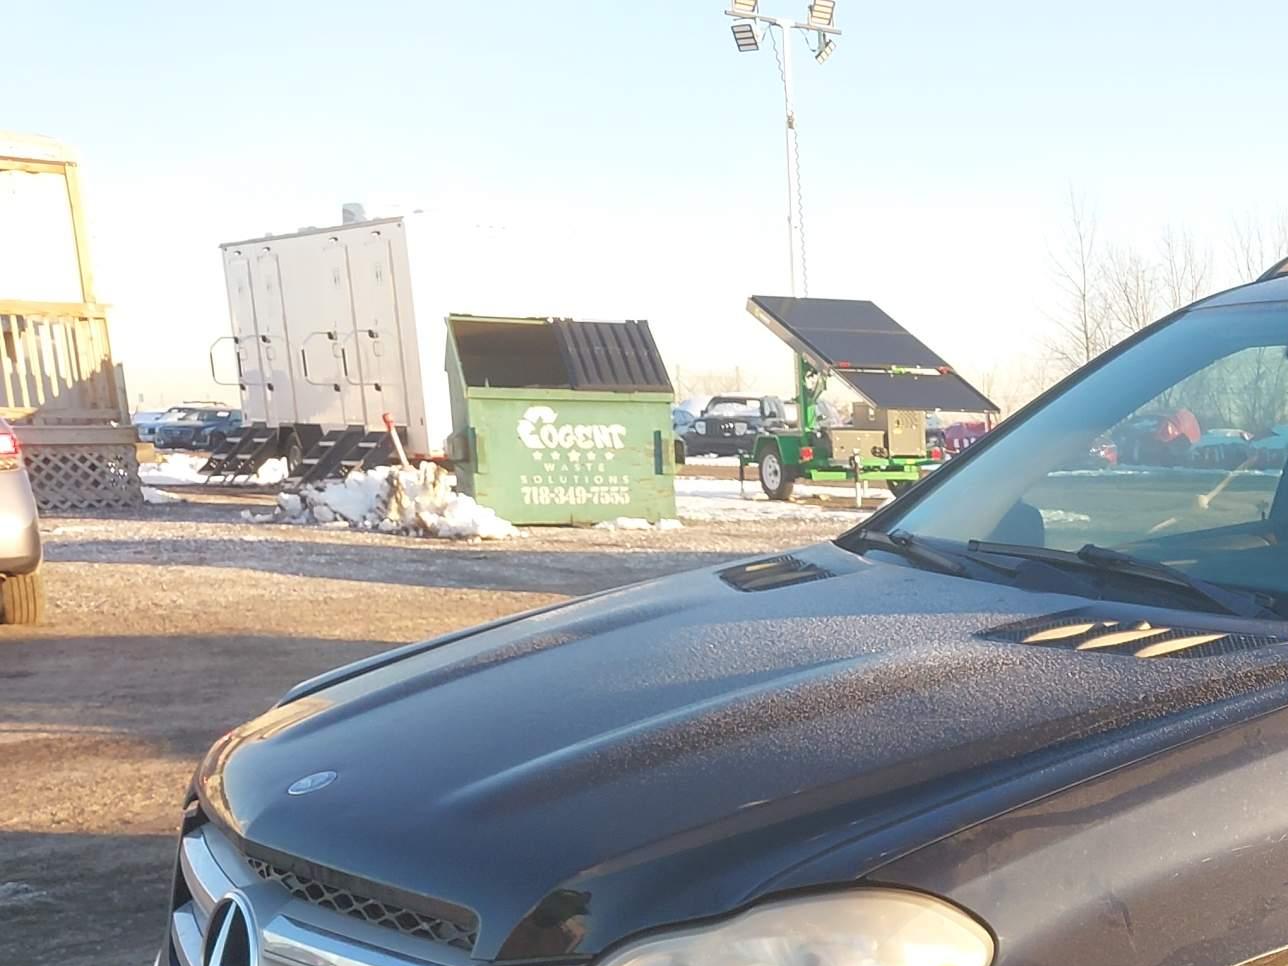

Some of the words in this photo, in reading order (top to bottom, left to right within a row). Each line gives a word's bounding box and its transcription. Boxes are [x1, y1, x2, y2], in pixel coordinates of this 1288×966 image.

[543, 462, 606, 473] WASTE
[520, 475, 630, 485] SOLUTIONS
[520, 486, 631, 505] 718-349-7555
